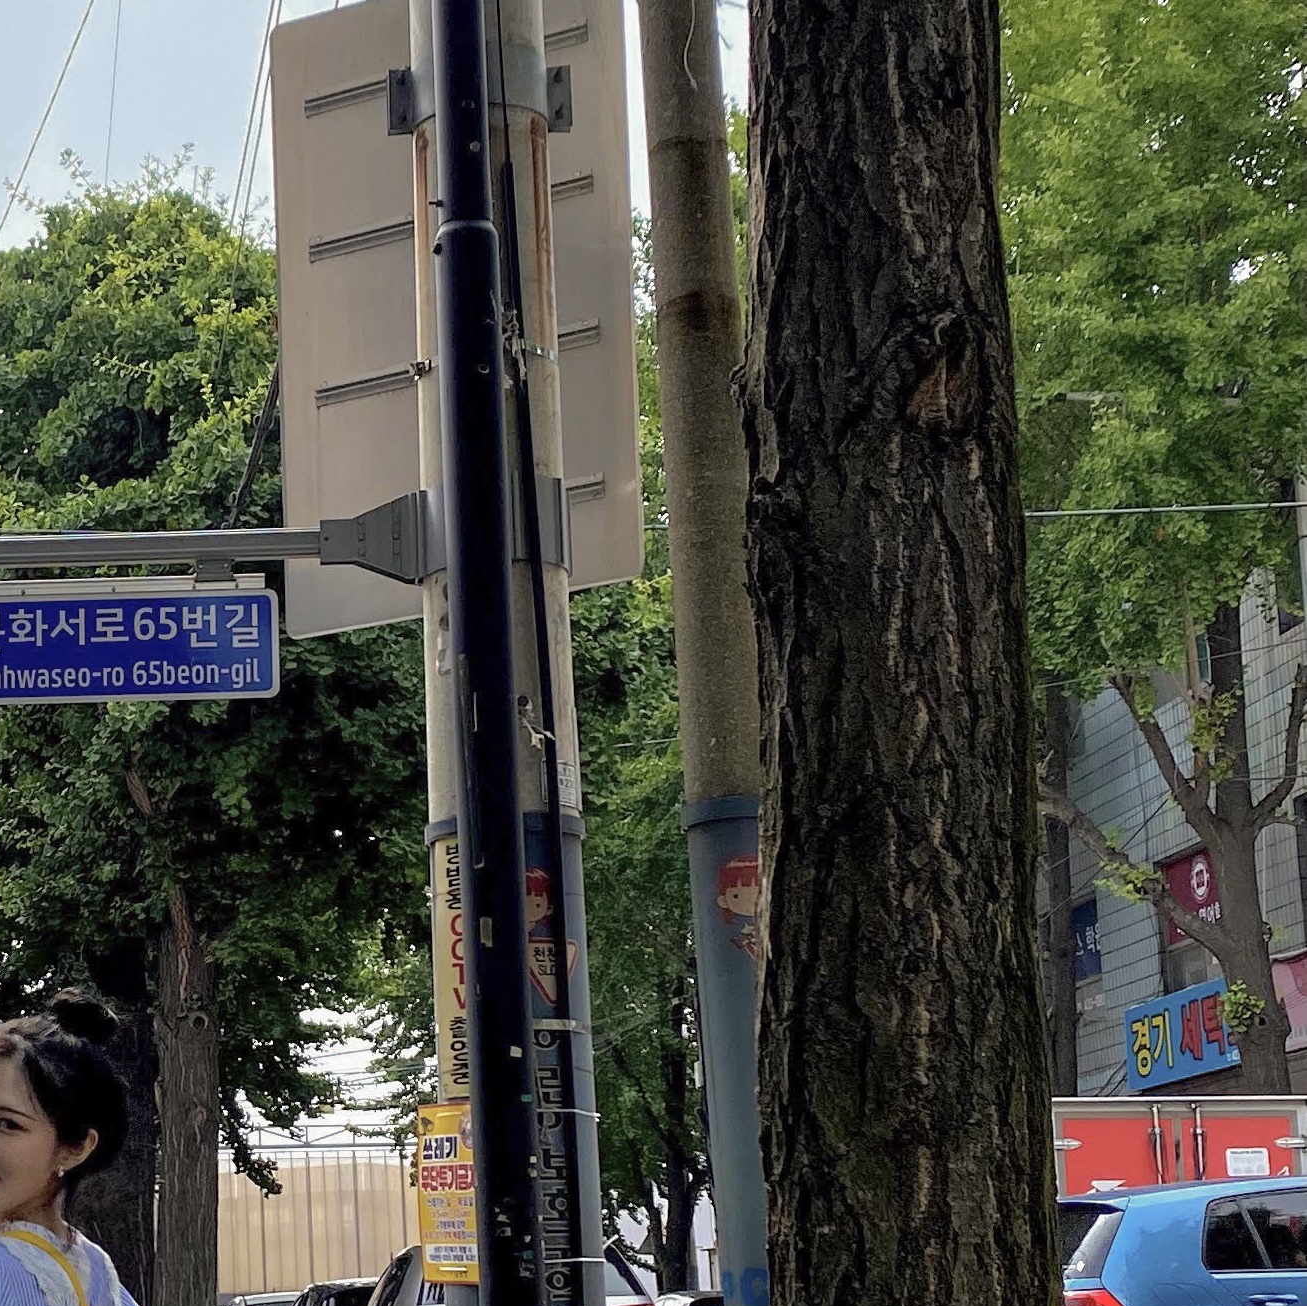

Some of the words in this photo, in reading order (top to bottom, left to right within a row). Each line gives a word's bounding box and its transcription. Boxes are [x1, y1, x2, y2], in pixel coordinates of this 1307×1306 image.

[132, 658, 261, 689] 65beon-gil
[1131, 1007, 1174, 1077] 경기
[1179, 990, 1240, 1061] 세탁
[422, 1135, 458, 1160] 쓰레기
